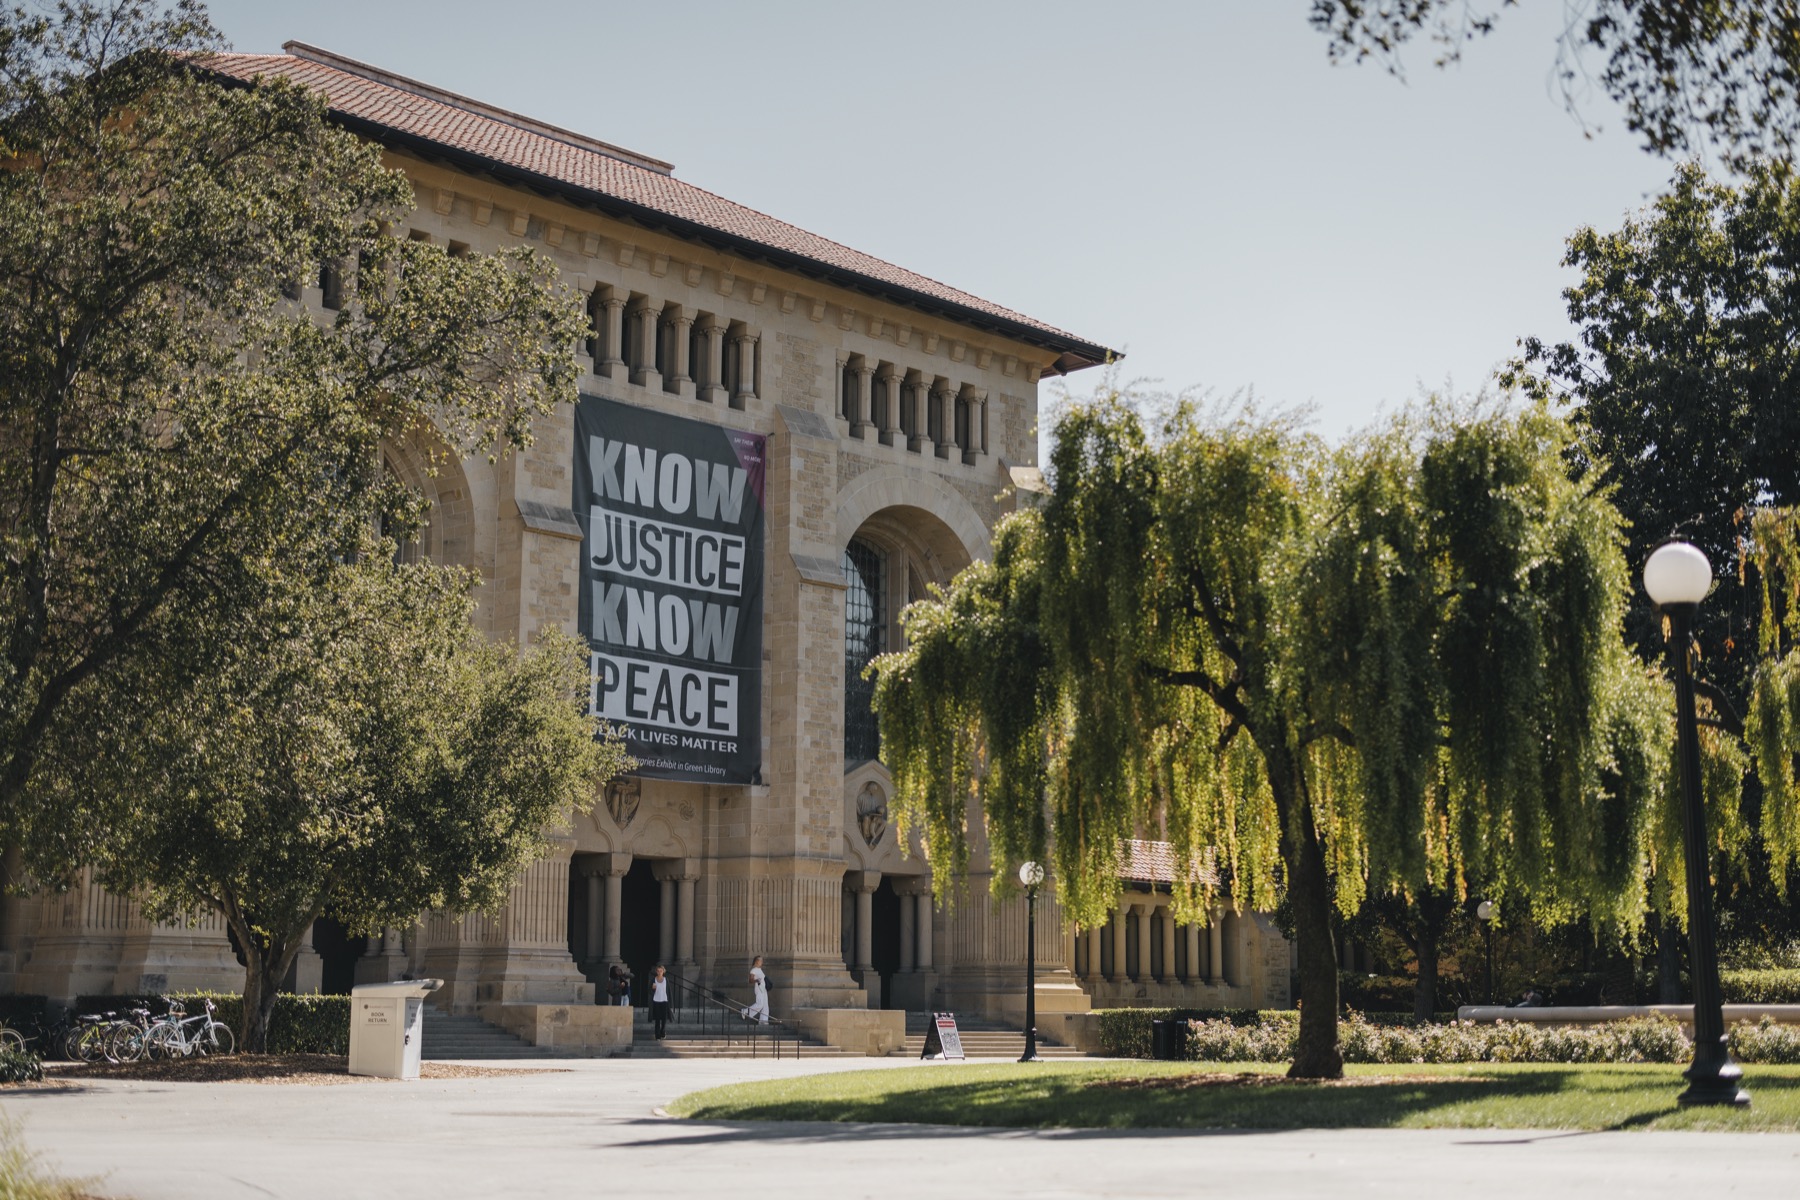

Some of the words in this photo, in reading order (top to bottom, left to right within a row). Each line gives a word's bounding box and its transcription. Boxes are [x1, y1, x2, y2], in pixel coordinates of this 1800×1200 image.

[590, 435, 748, 524] KNOW
[592, 513, 743, 592] JUSTICE
[592, 579, 740, 664] KNOW
[595, 656, 730, 731] PEACE
[594, 723, 637, 740] LACK
[640, 730, 678, 746] LIVES
[681, 737, 738, 753] MATTER
[630, 755, 655, 768] braries
[656, 758, 677, 770] Exhibit
[677, 762, 684, 770] in
[684, 762, 703, 774] Green
[704, 764, 727, 777] Library
